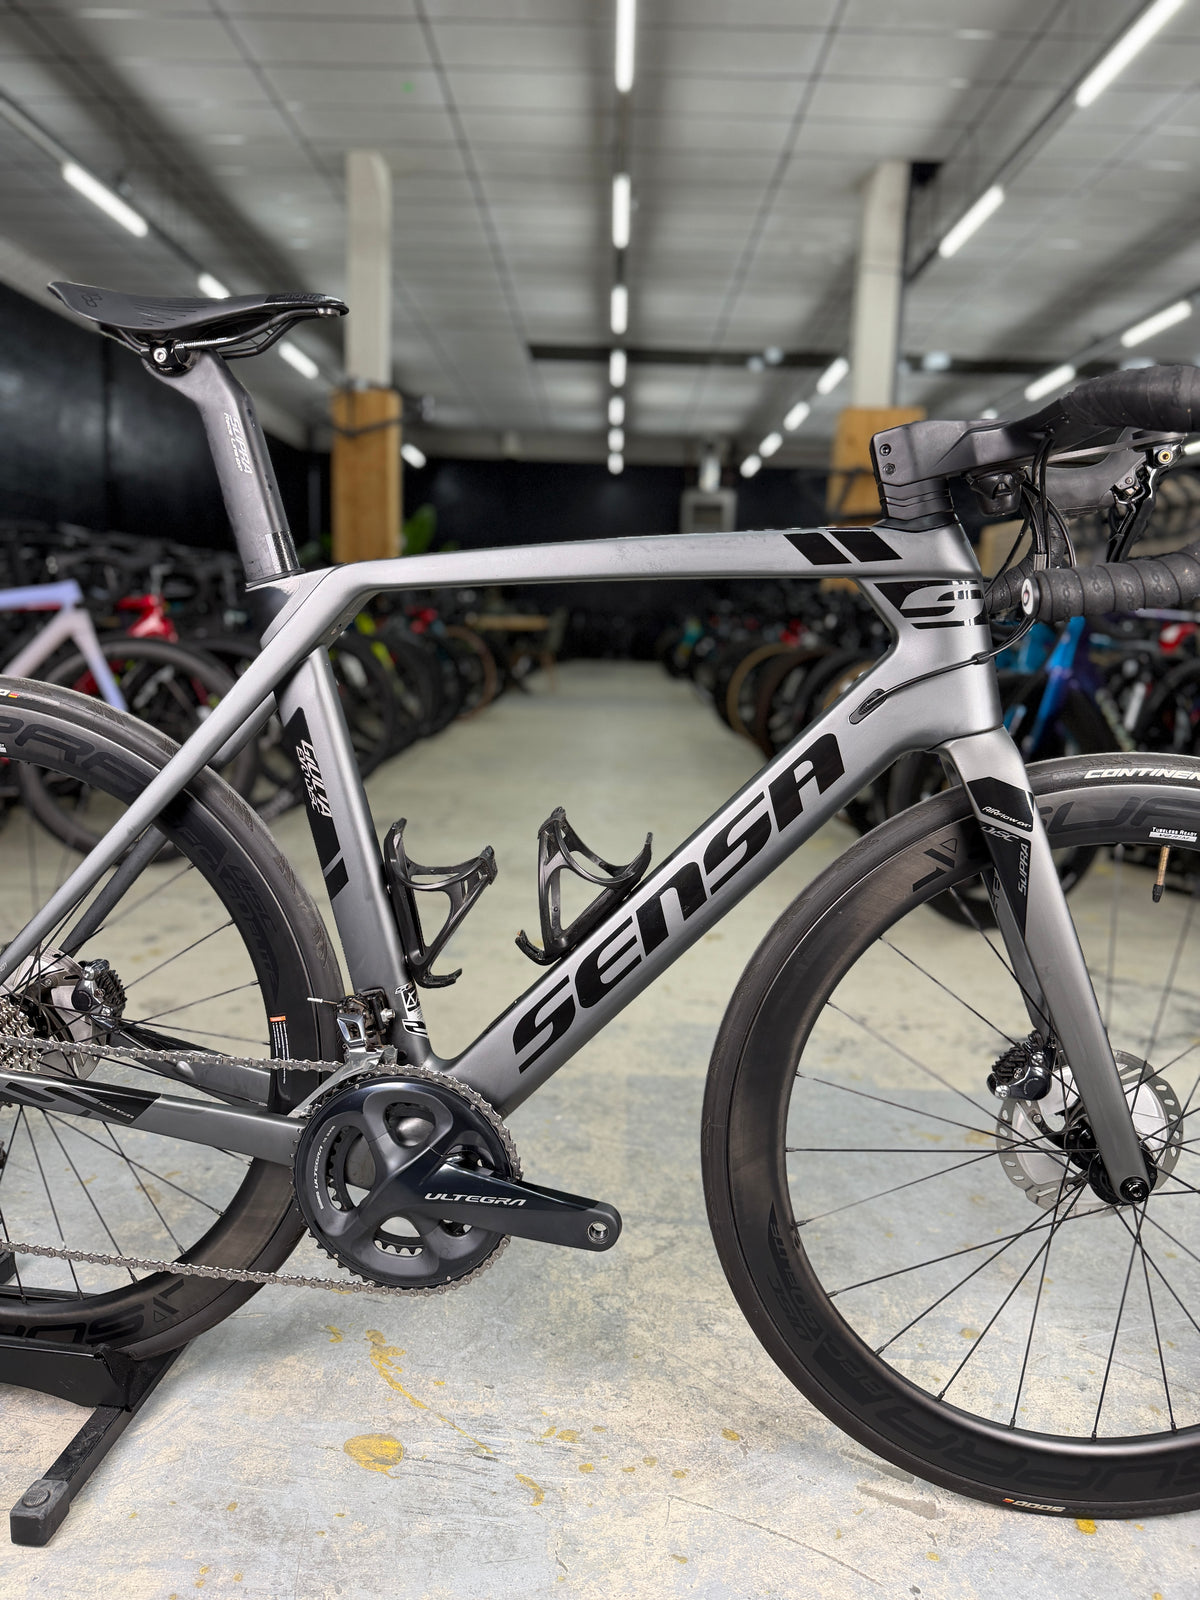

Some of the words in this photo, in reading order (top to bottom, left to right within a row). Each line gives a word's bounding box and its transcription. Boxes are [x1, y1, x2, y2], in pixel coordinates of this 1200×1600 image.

[229, 415, 252, 473] SUPRA
[301, 740, 332, 818] GIULIA
[1017, 842, 1029, 896] SUPRA
[513, 733, 846, 1074] SENSA
[313, 1145, 323, 1188] ULTEGRA
[424, 1192, 527, 1206] ULTEGRA
[1013, 1499, 1066, 1513] 5000
